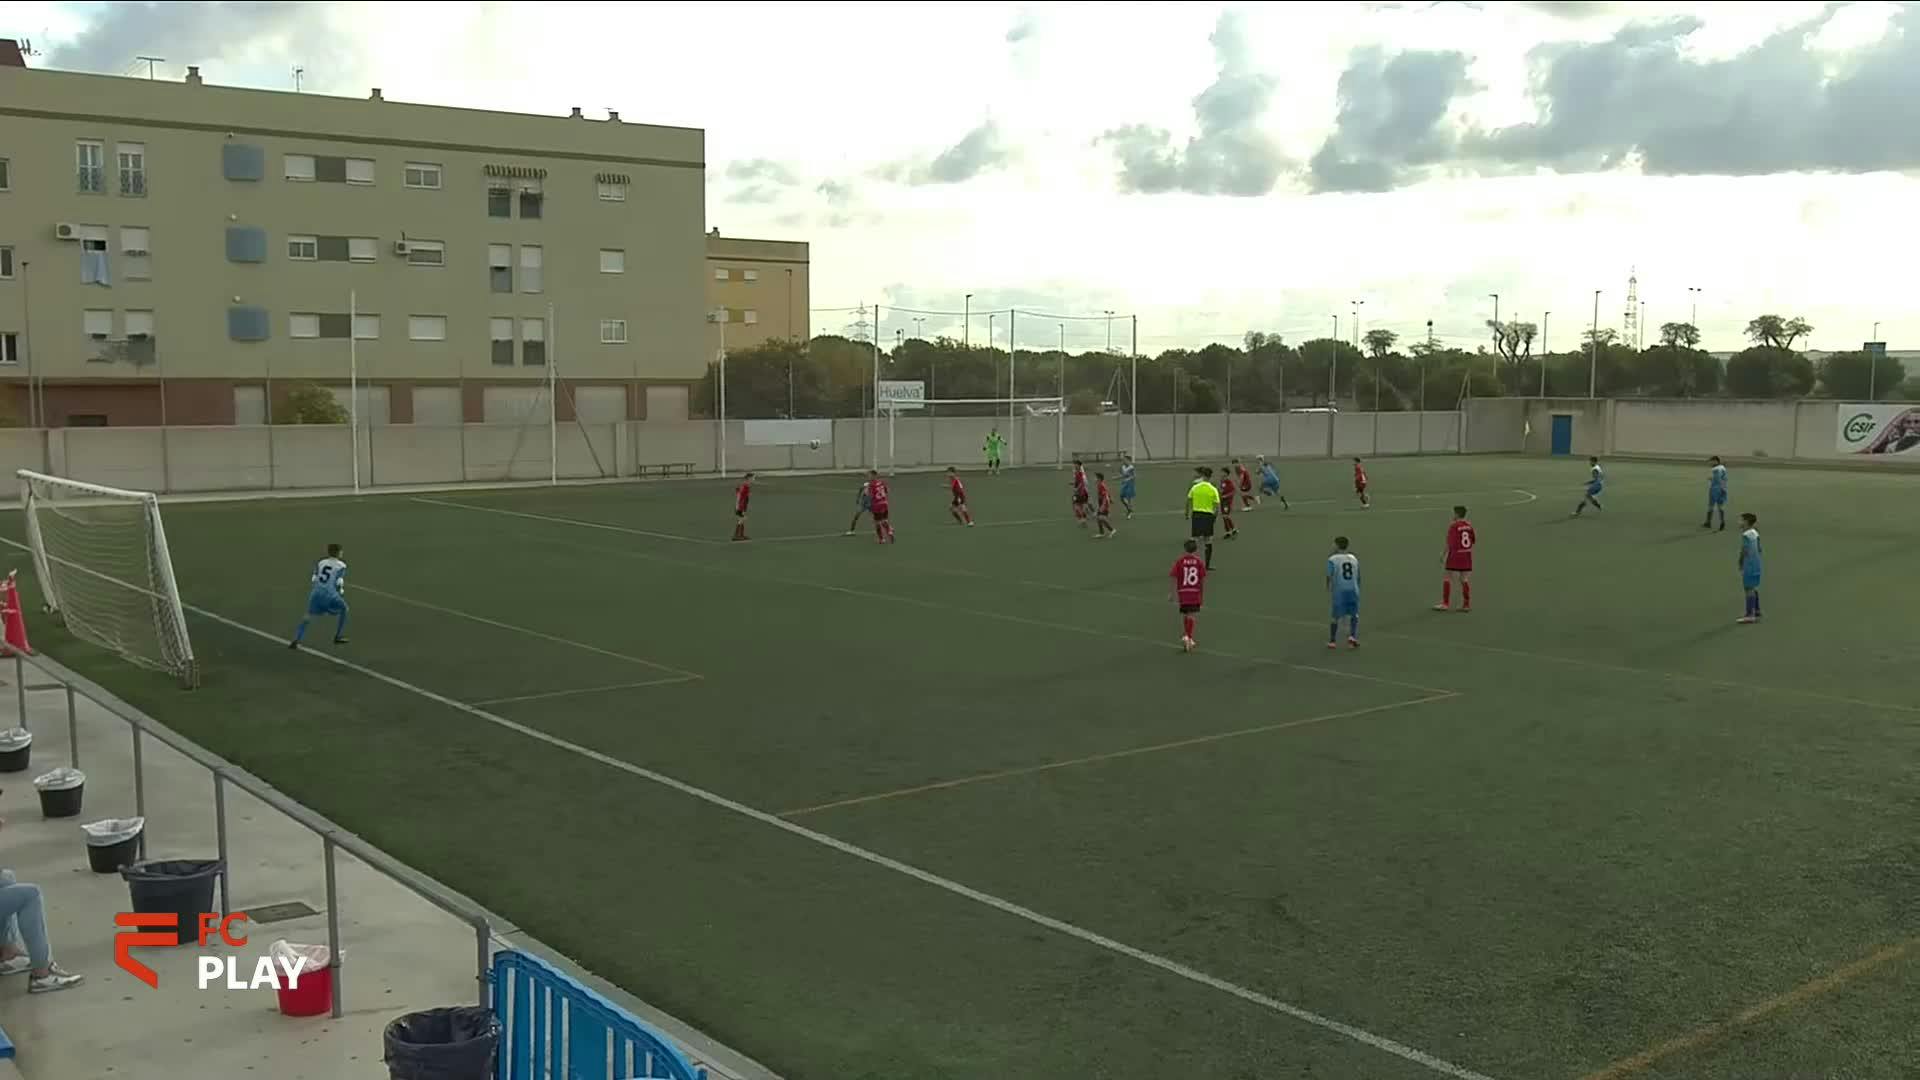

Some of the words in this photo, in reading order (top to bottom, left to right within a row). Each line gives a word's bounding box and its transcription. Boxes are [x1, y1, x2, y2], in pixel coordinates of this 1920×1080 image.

[1461, 531, 1471, 548] 8
[319, 565, 332, 583] 5
[1183, 566, 1198, 586] 18
[1342, 562, 1353, 580] 8
